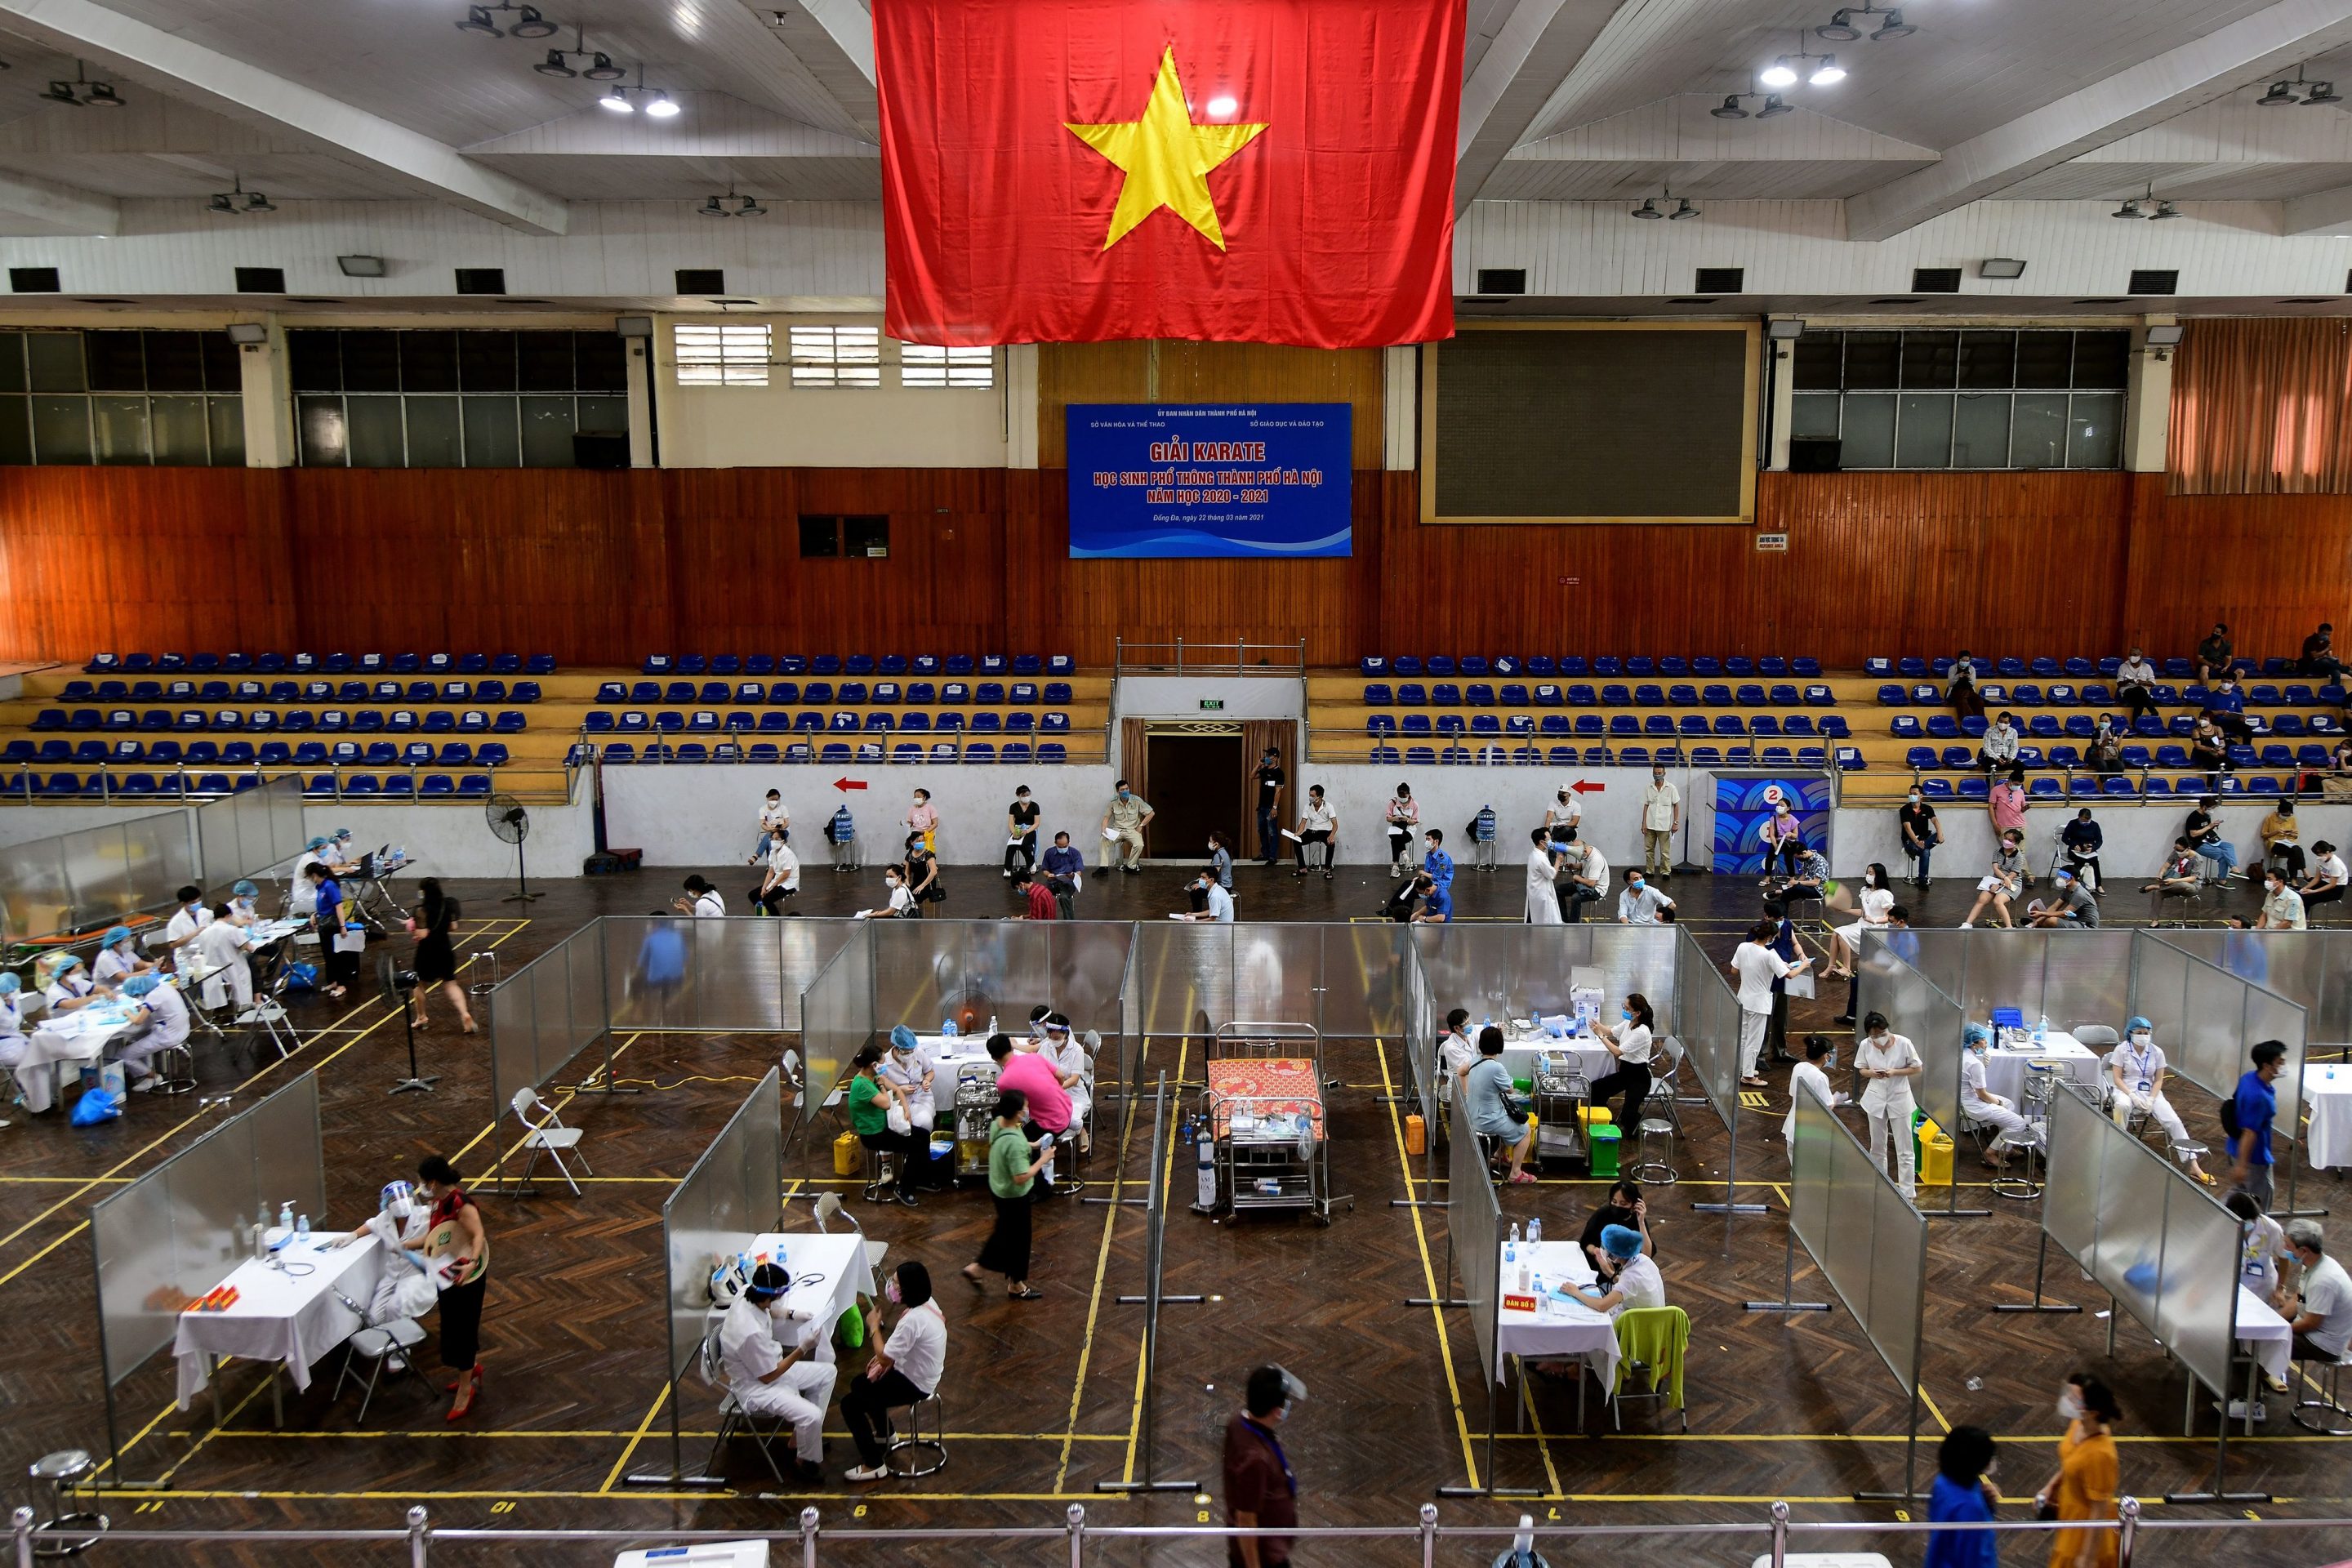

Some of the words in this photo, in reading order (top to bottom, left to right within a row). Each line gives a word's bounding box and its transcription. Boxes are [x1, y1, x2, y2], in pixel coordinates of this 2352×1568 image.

[1157, 408, 1165, 416] ỦY
[1246, 409, 1257, 417] NỘI
[1150, 434, 1189, 462] GIẢI
[1193, 442, 1266, 461] KARATE
[1094, 471, 1117, 488] HỌC
[1120, 471, 1148, 486] SINH
[1150, 466, 1174, 486] PHỔ
[1176, 468, 1214, 485] THÔNG
[1217, 468, 1254, 485] THÀNH
[1257, 466, 1281, 485] PHỐ
[1283, 468, 1299, 485] HÀ
[1301, 468, 1323, 488] NỘI
[1147, 487, 1174, 503] NĂM
[1176, 489, 1200, 506] HỌC
[1202, 489, 1231, 503] 2020
[1241, 489, 1268, 503] 2021
[1153, 514, 1169, 522] Đống
[1170, 514, 1181, 522] Đa,
[1183, 514, 1197, 523] ngày
[1207, 514, 1224, 523] tháng
[1768, 789, 1778, 800] 2
[1197, 1510, 1209, 1523] 8
